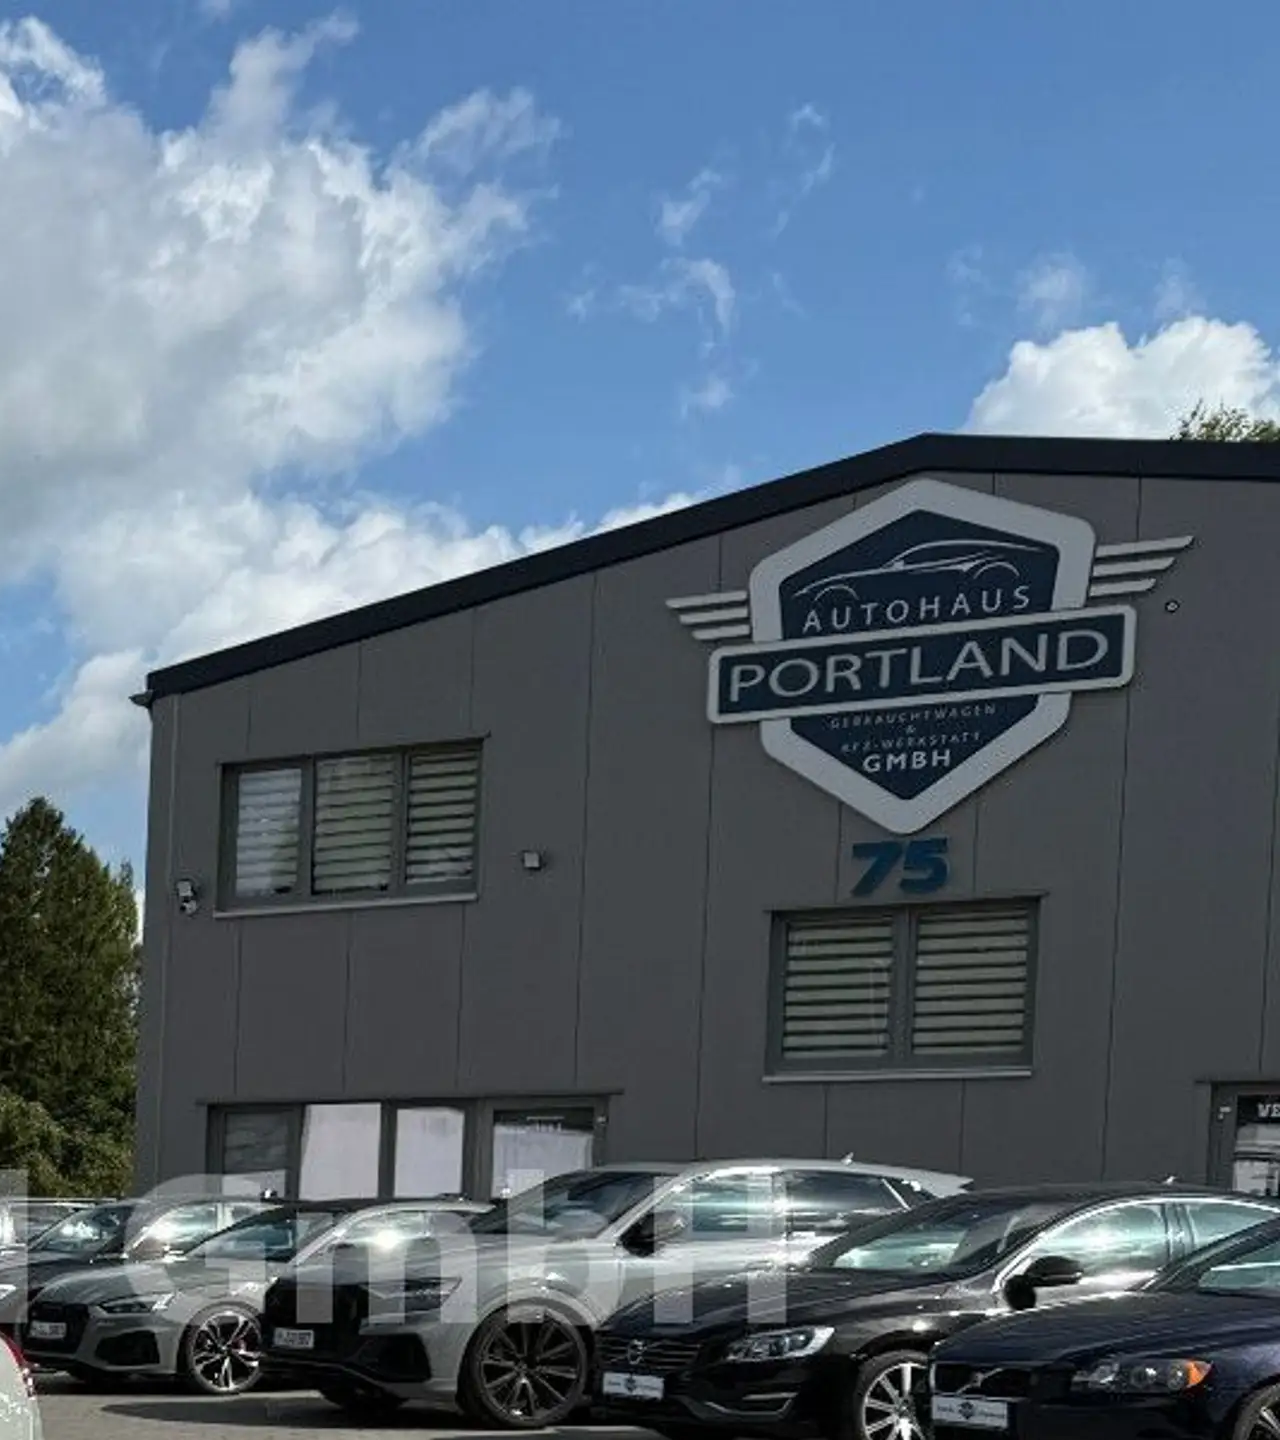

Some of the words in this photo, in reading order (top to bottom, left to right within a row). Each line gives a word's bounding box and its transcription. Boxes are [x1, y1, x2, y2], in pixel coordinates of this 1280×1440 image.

[802, 585, 1031, 634] AUTOHAUS
[729, 630, 1109, 702] PORTLAND
[862, 749, 952, 773] GMBH
[849, 836, 950, 897] 75
